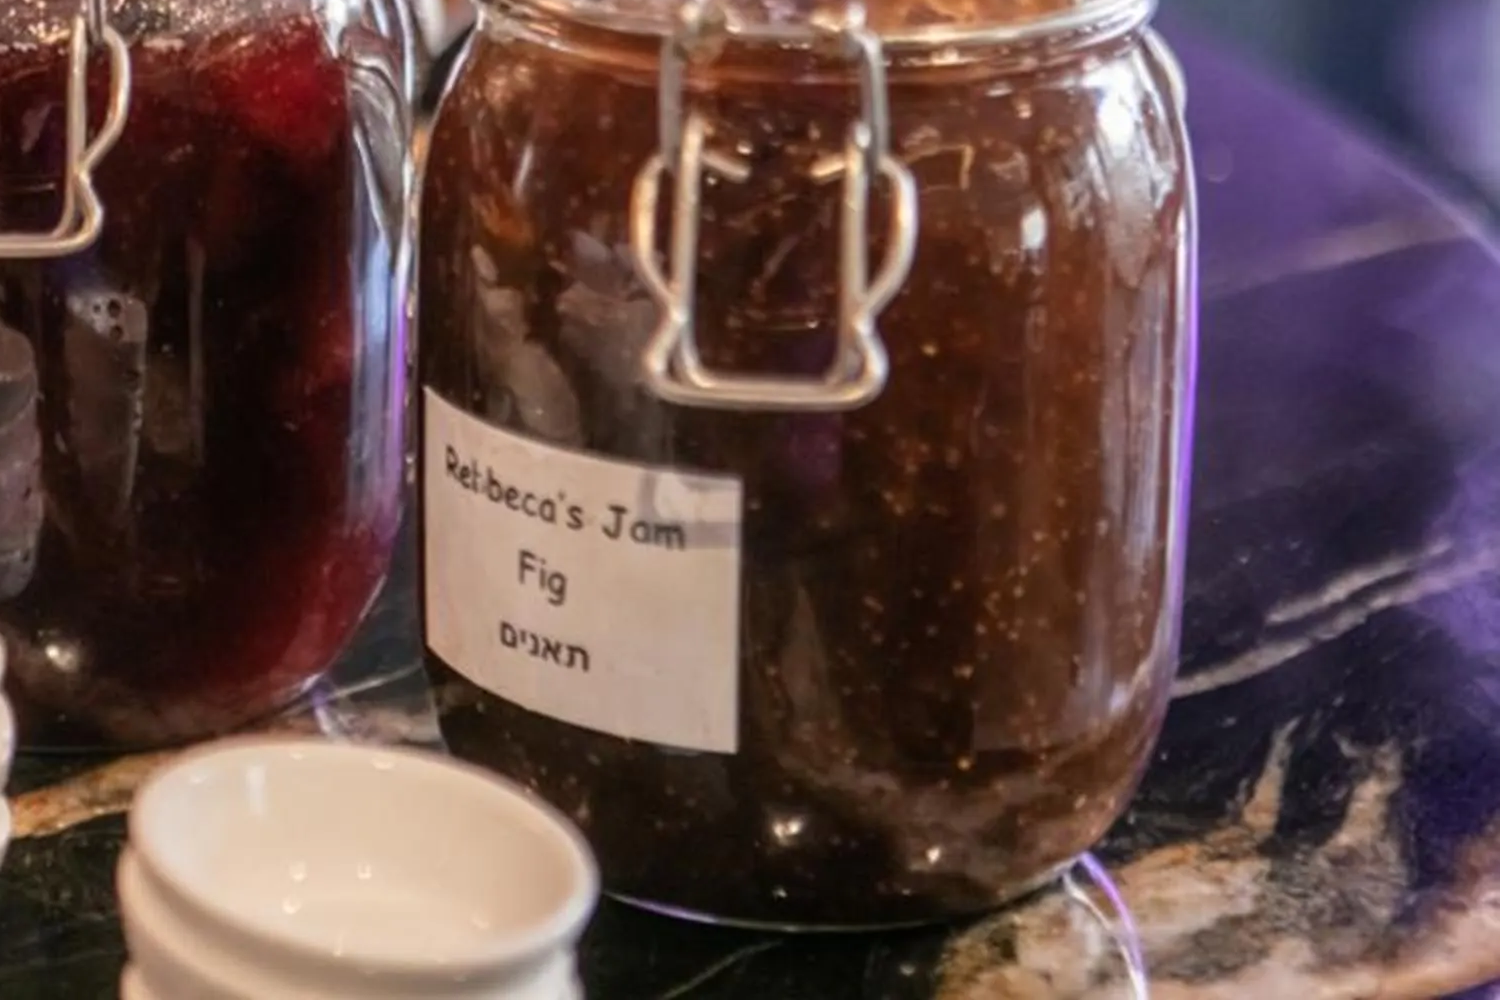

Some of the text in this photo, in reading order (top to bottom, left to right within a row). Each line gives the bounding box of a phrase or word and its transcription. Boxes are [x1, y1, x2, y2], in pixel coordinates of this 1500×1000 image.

[444, 444, 687, 552] Rebbeca's Jam
[517, 549, 568, 608] Fig
[499, 621, 591, 673] תאנים
